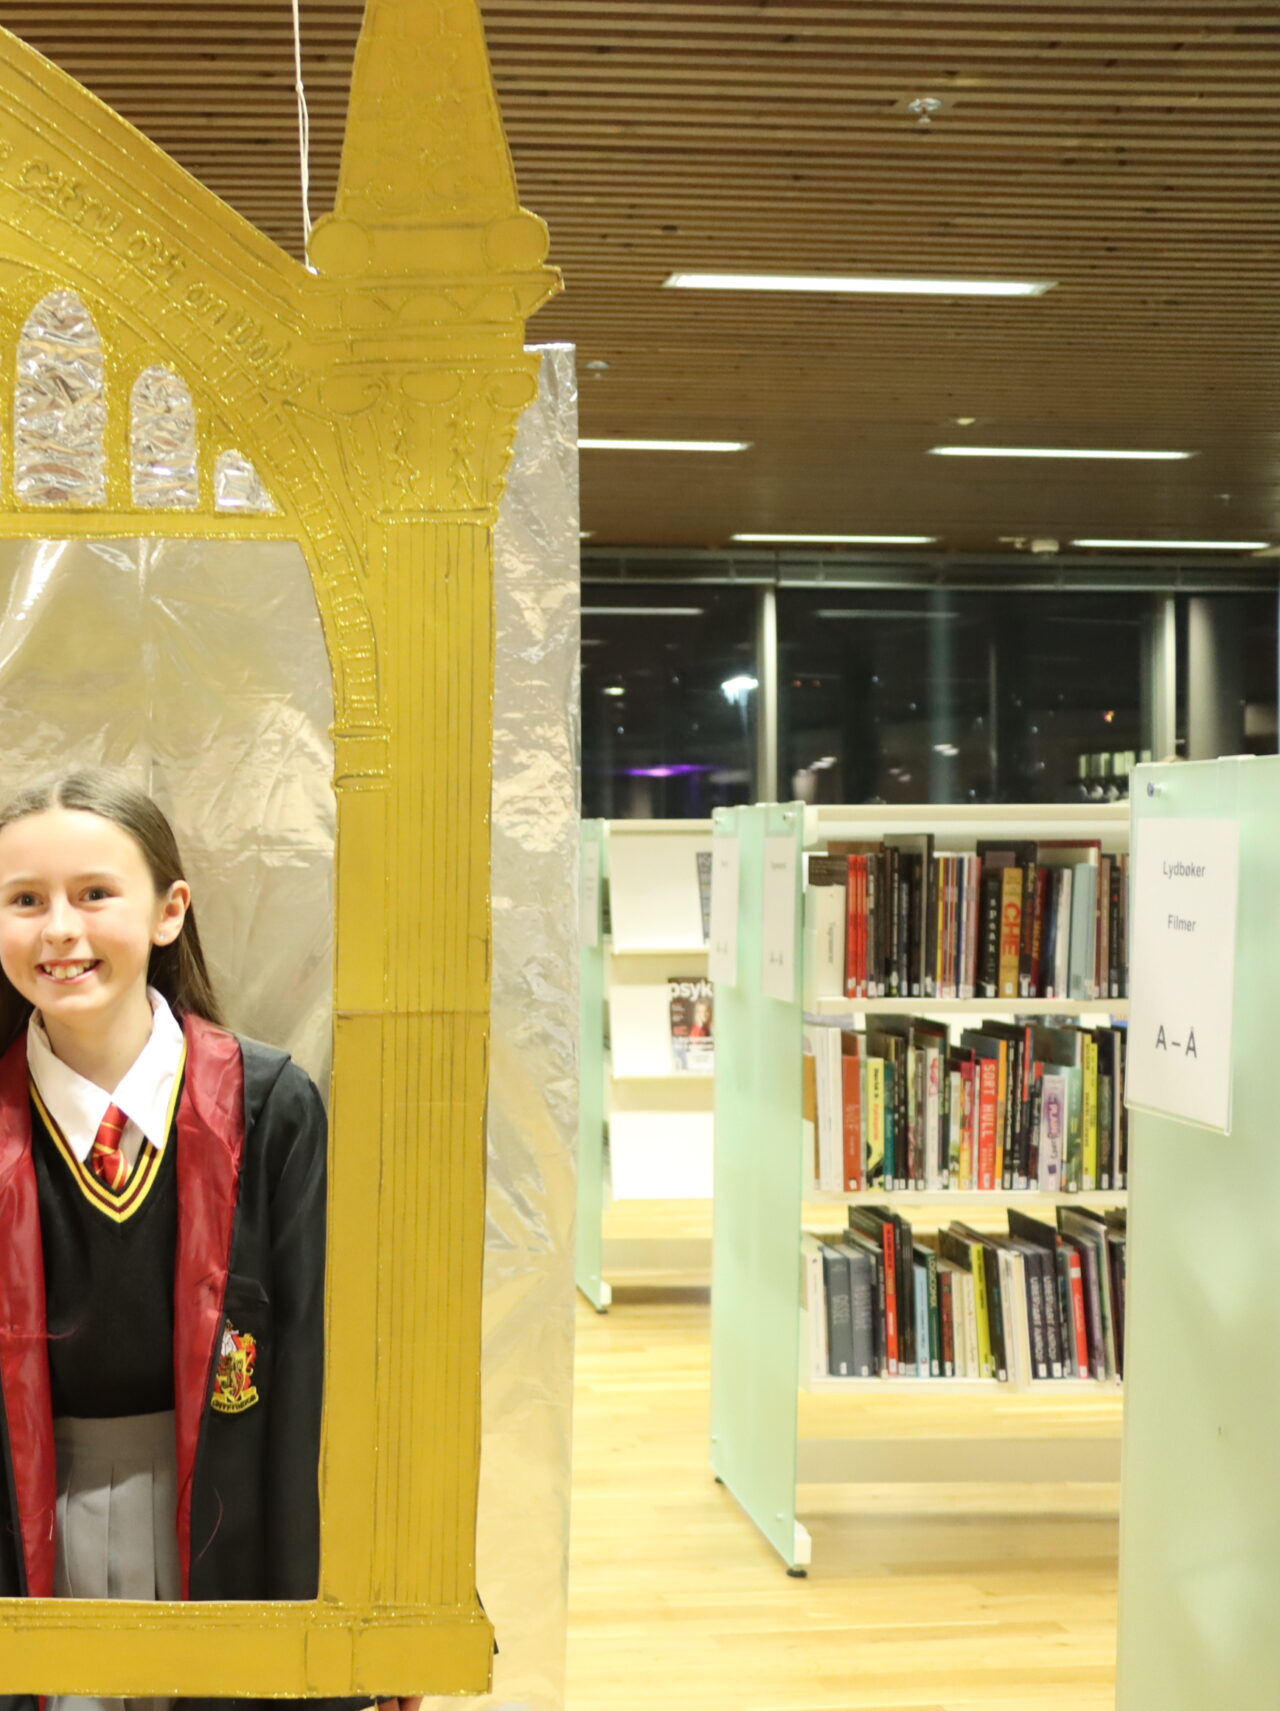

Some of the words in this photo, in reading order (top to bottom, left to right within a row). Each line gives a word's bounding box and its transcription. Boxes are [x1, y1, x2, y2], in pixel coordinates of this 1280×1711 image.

[1163, 861, 1206, 879] Lydbøker
[1003, 902, 1021, 957] CHE
[1168, 914, 1197, 932] Filmer
[983, 1064, 996, 1096] SORT
[981, 1104, 995, 1140] HULL
